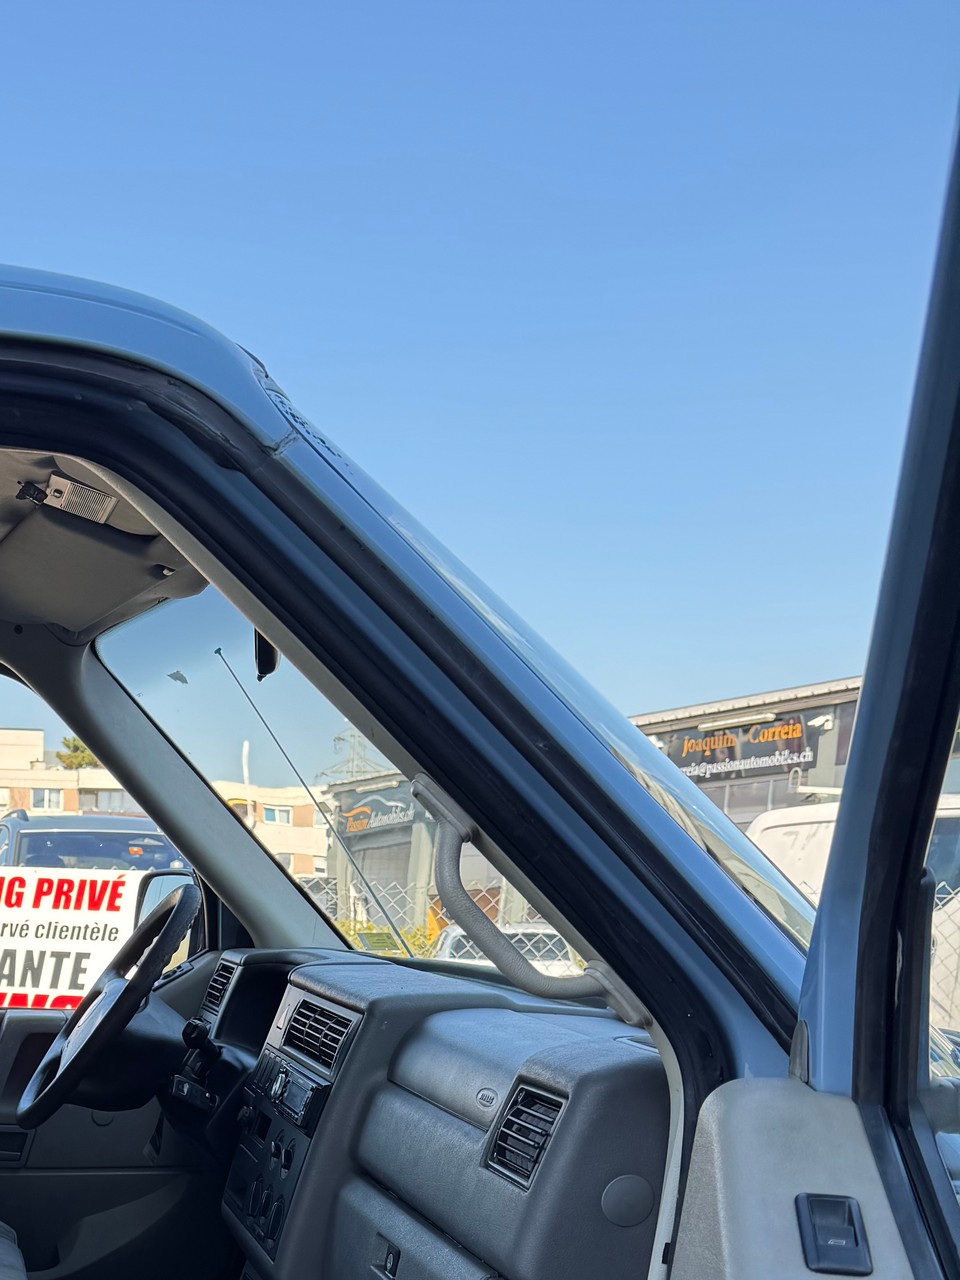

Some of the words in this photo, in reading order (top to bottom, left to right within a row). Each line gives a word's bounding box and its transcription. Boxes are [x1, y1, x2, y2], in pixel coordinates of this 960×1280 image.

[748, 719, 802, 743] Correia
[32, 875, 126, 912] PRIVÉ
[35, 921, 119, 942] clientèle
